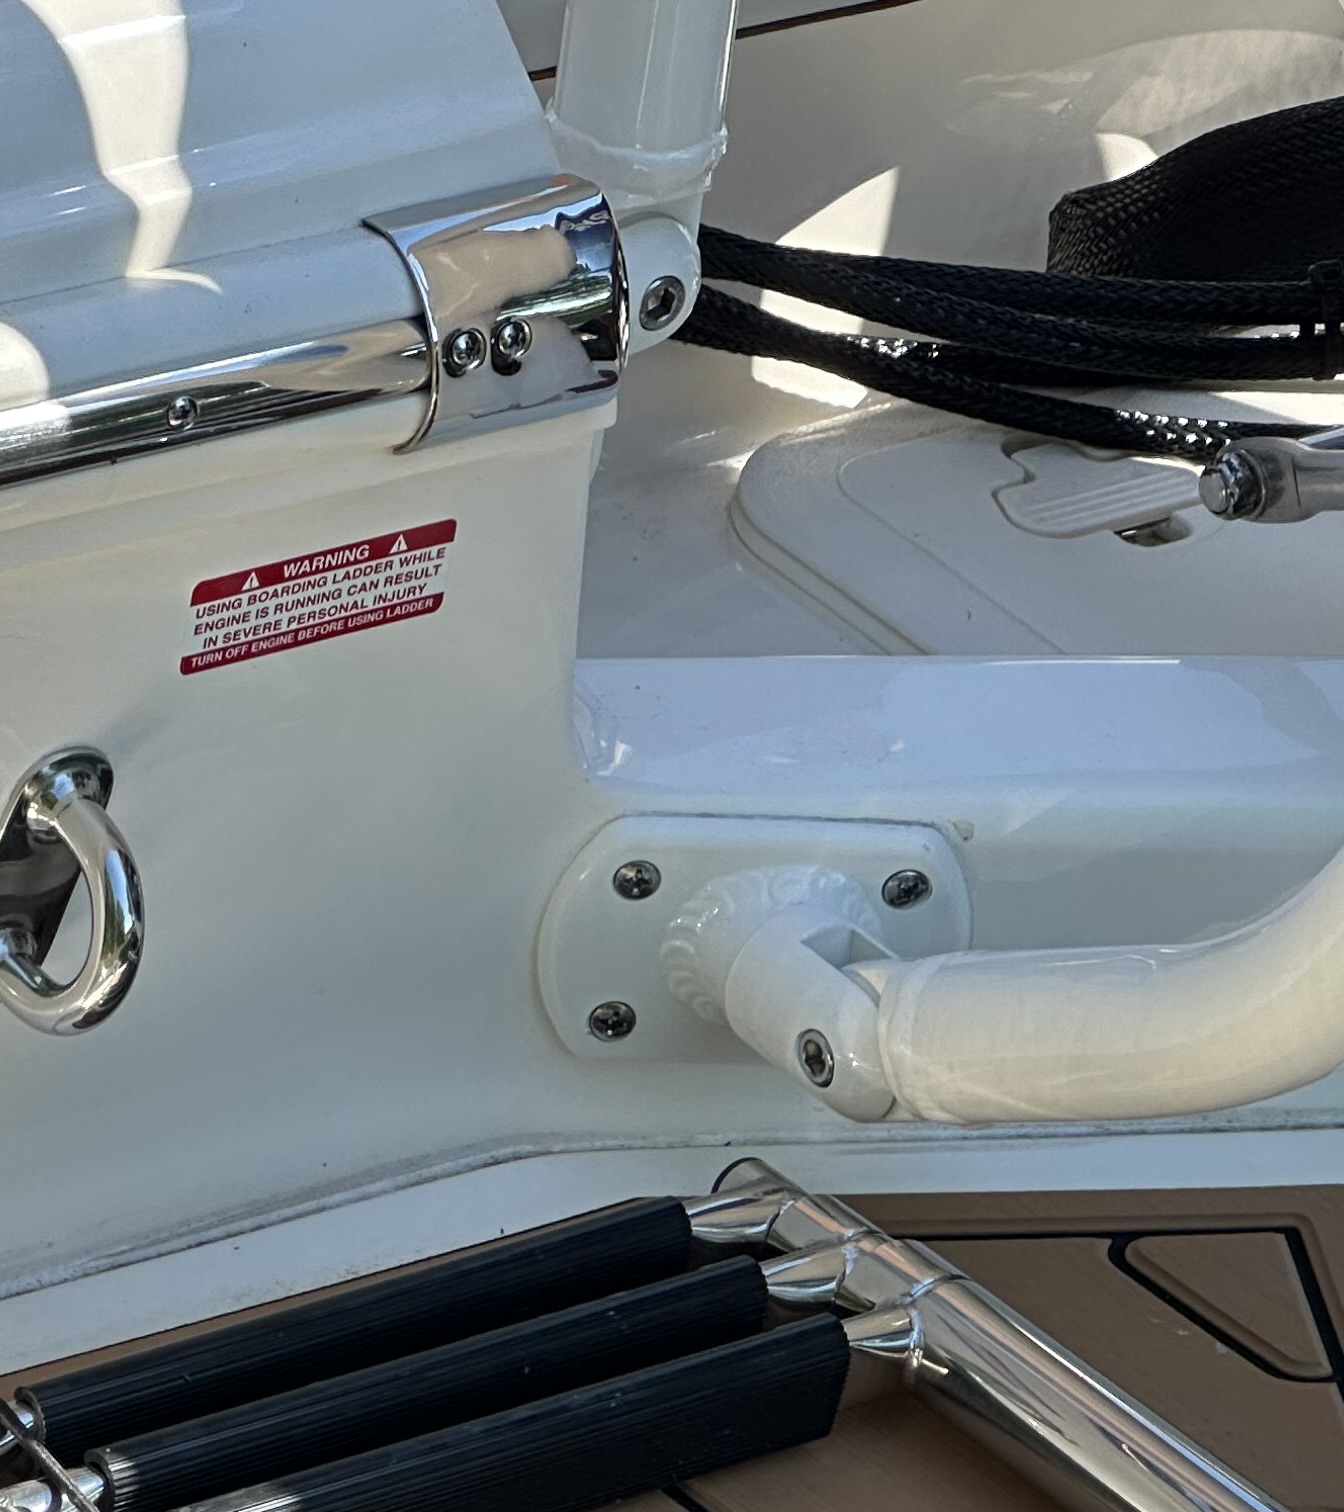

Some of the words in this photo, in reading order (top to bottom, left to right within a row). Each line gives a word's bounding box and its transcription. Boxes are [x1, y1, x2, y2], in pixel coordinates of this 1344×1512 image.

[196, 599, 242, 619] USING
[248, 577, 327, 606] BOARDING
[332, 560, 394, 585] LADDER
[400, 547, 446, 567] WHILE
[284, 544, 370, 578] WARNING
[191, 650, 223, 668] TURN
[226, 646, 248, 659] OFF
[251, 635, 295, 653] ENGINE
[298, 621, 345, 641] BEFORE
[348, 613, 383, 627] USING
[386, 598, 433, 618] LADDER
[194, 611, 251, 636] ENGINE
[256, 605, 269, 619] IS
[274, 589, 342, 615] RUNNING
[347, 578, 379, 595] CAN
[384, 564, 442, 588] RESULT
[203, 635, 218, 649] IN
[222, 621, 282, 644] SEVERE
[287, 599, 368, 628] PERSONAL
[373, 583, 427, 606] INJURY
